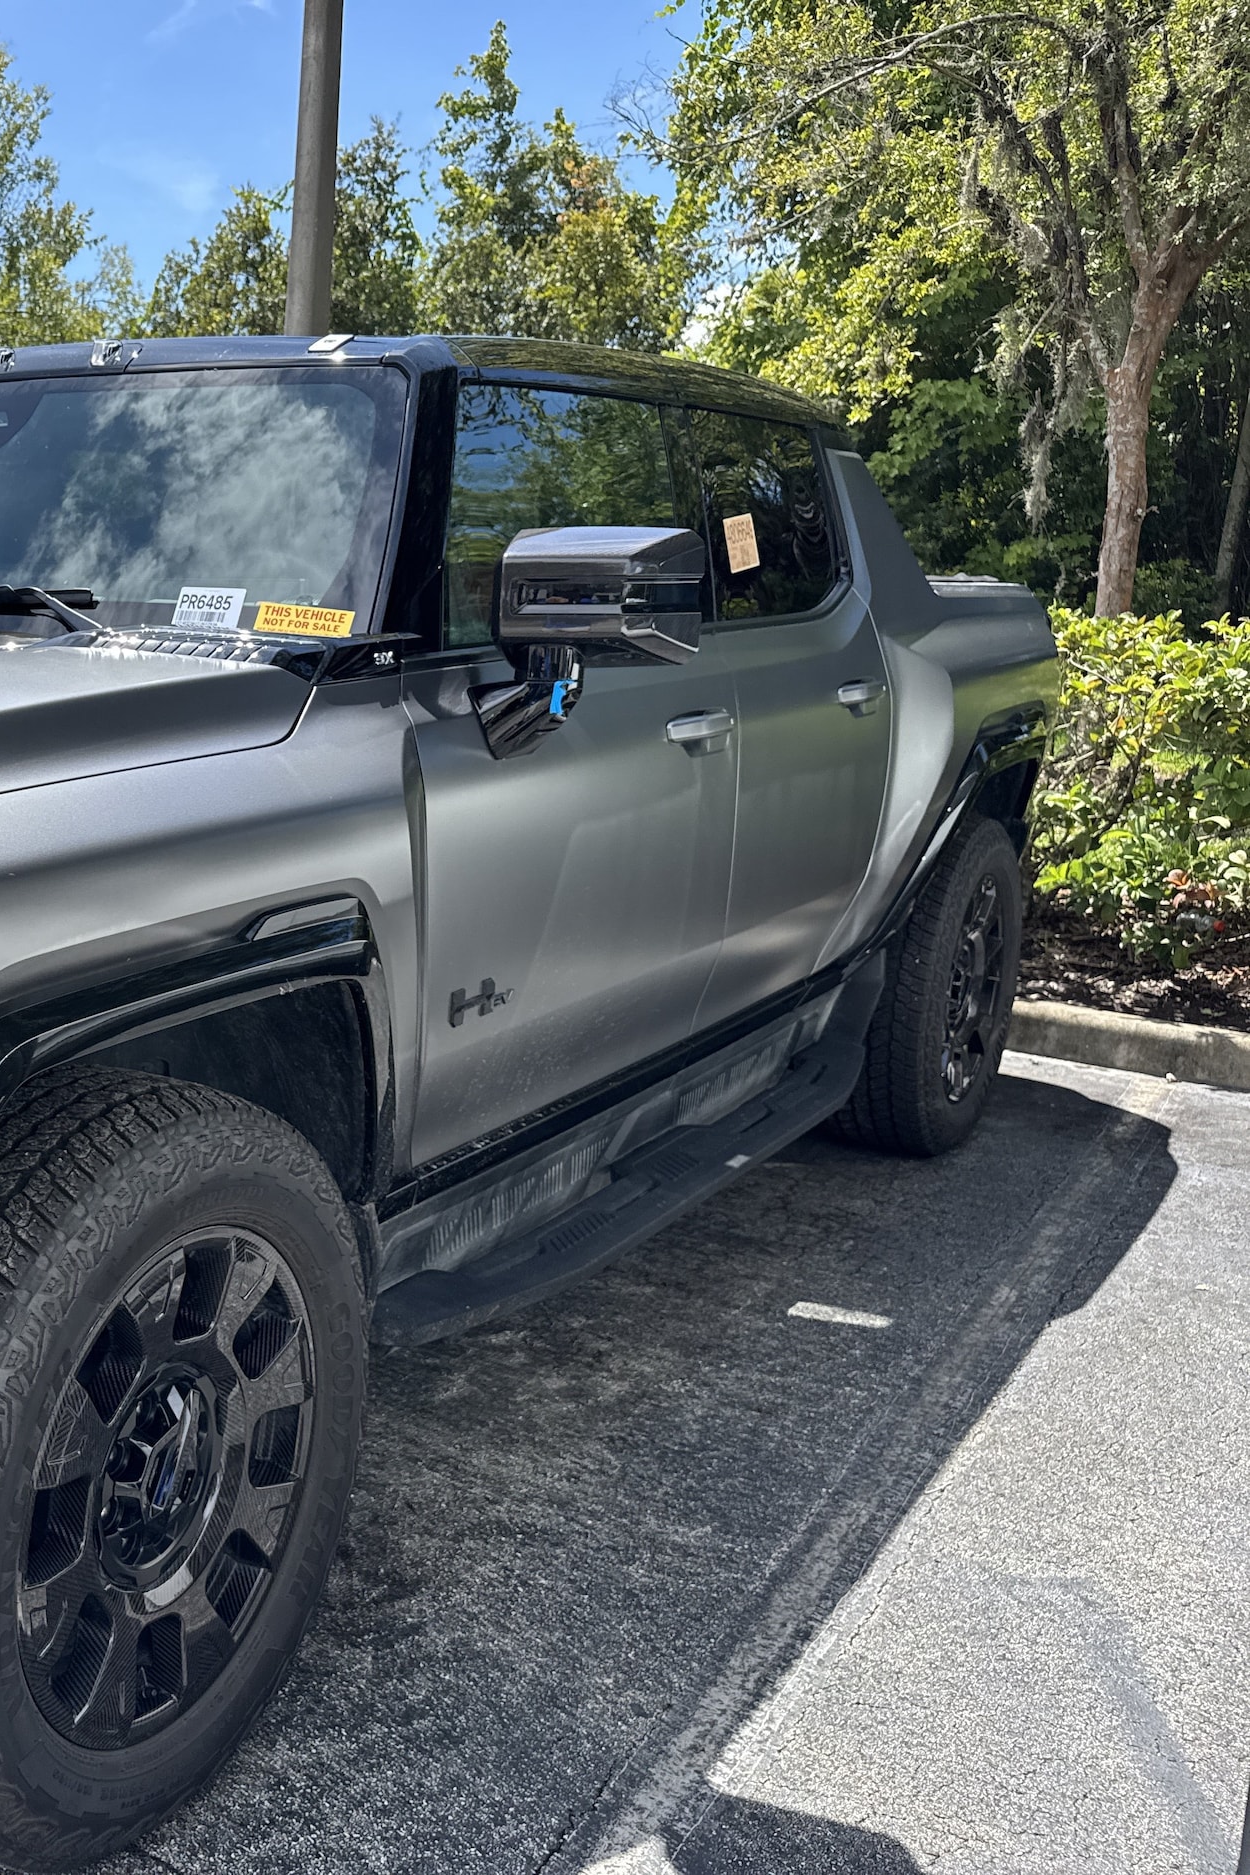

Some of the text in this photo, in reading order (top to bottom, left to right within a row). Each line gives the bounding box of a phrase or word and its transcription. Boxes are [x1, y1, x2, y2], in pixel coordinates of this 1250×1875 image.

[179, 594, 234, 611] PR6485
[264, 605, 347, 624] THIS VEHICLE
[262, 617, 285, 627] NOT
[287, 620, 310, 630] FOR
[312, 622, 341, 633] SALE
